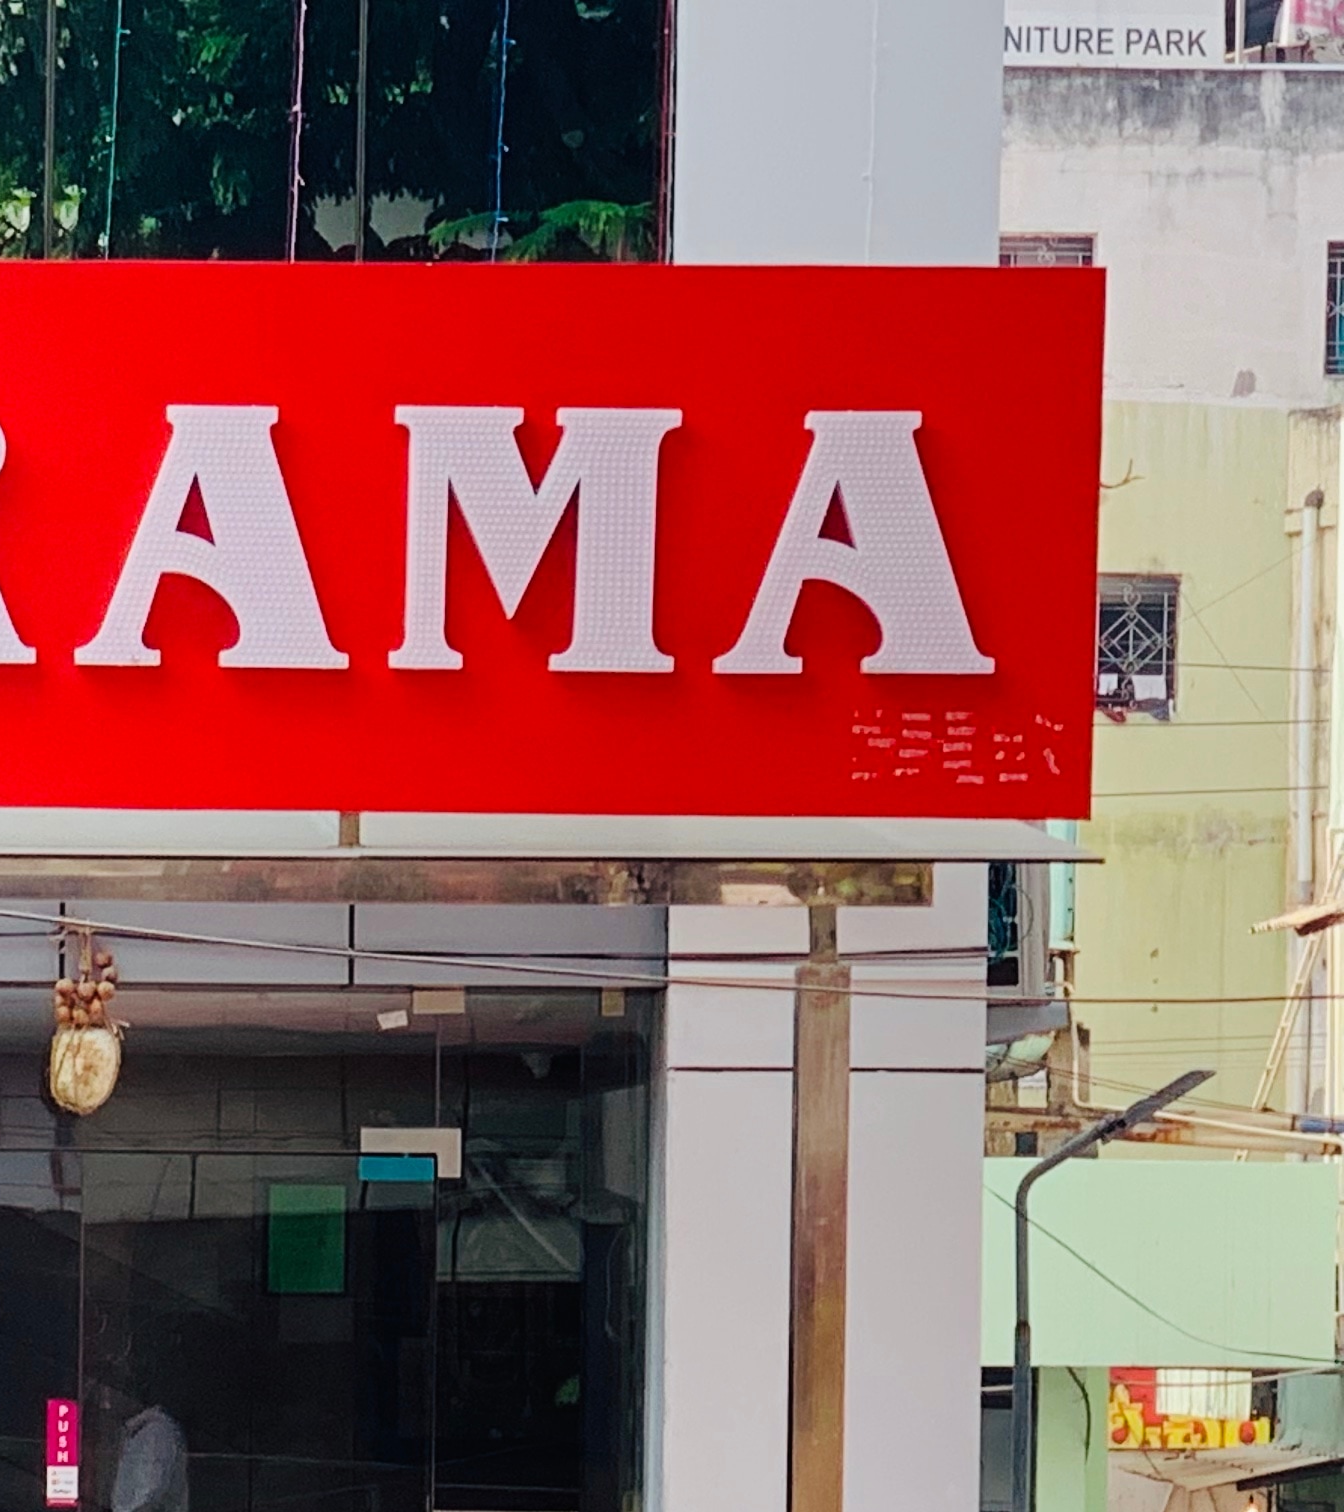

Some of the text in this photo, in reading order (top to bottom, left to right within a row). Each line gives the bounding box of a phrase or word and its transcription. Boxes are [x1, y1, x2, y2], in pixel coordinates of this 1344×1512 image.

[1003, 26, 1207, 57] NITURE PARK
[56, 1404, 70, 1463] PUSH
